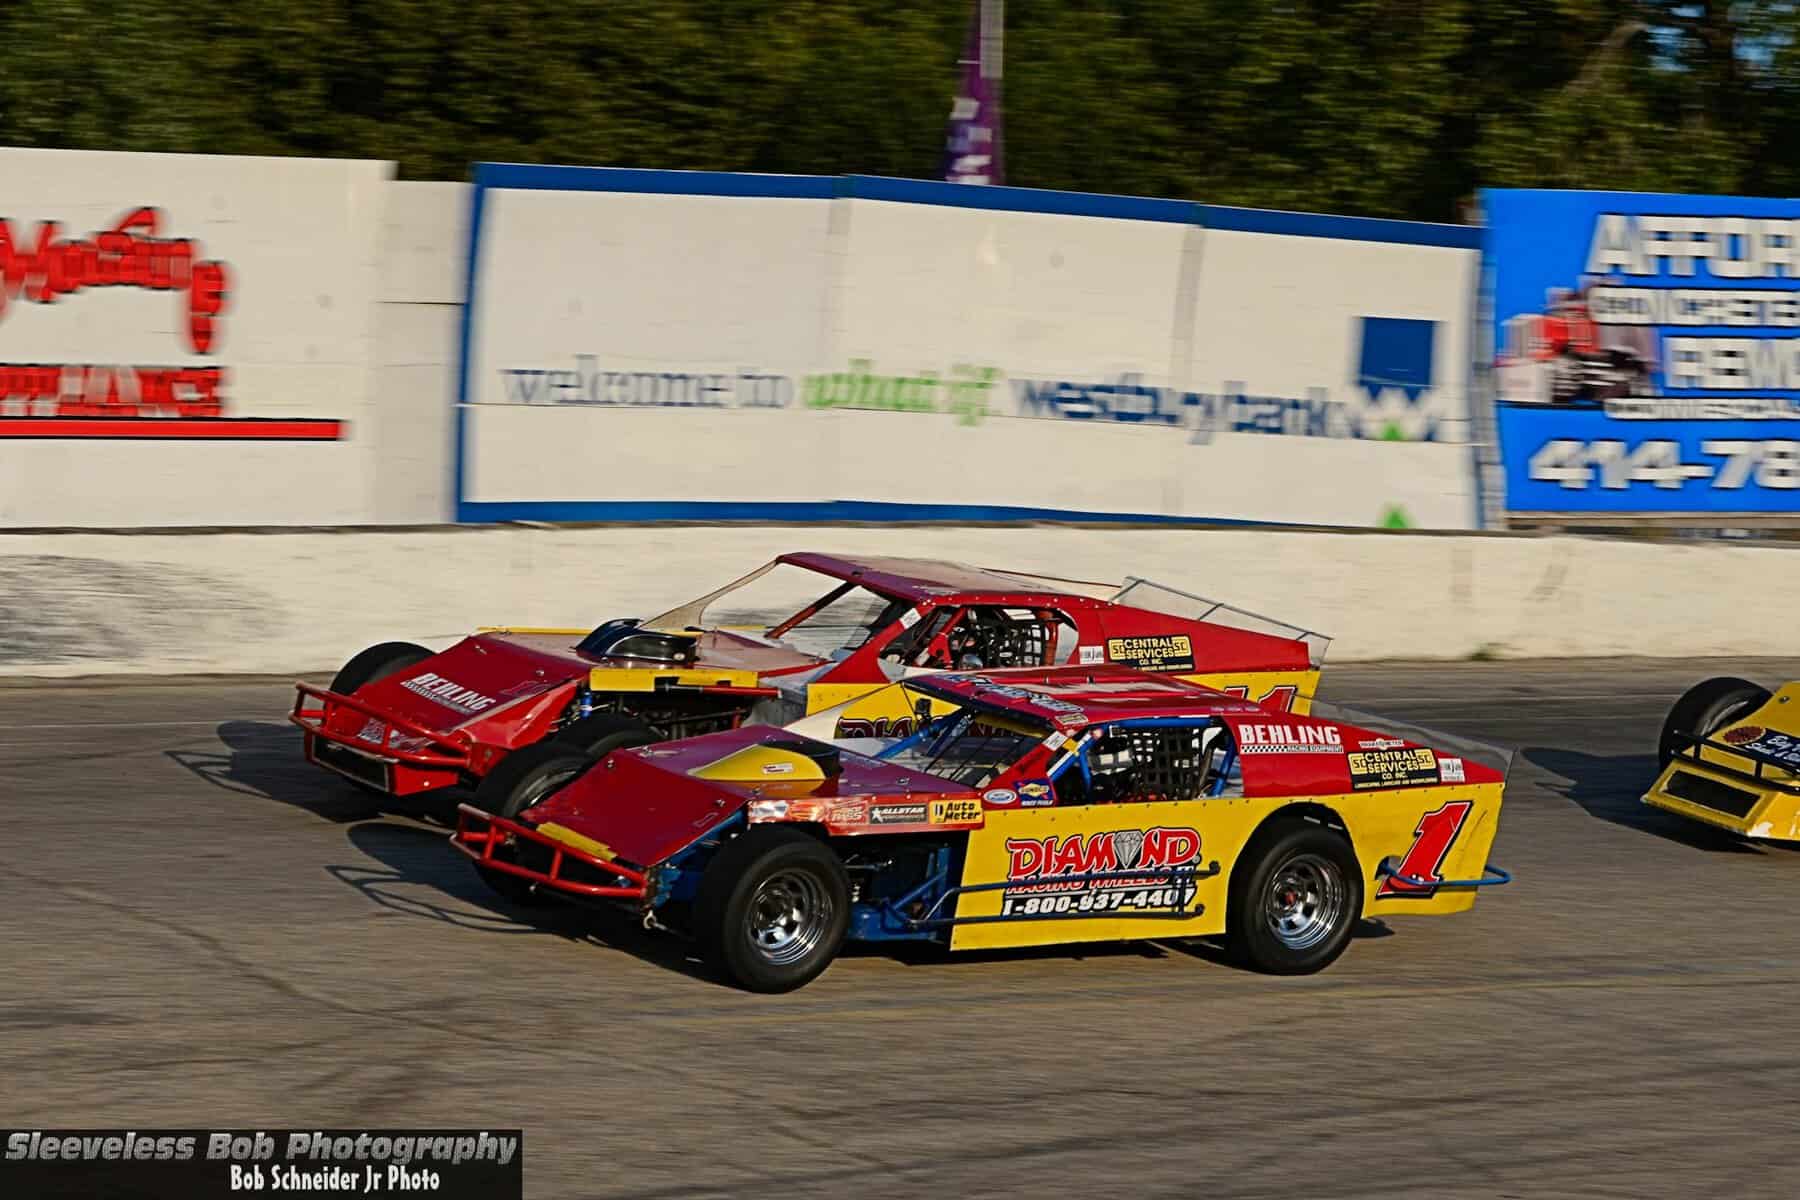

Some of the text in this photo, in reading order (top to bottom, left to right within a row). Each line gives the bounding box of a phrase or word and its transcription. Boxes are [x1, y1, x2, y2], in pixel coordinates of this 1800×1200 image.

[499, 355, 731, 407] welcome
[1124, 638, 1172, 649] CENTRAL
[1126, 648, 1174, 659] SERVICES
[410, 672, 496, 711] BEHLING
[1238, 724, 1341, 745] BEHLING
[1365, 750, 1417, 763] CENTRAL
[1367, 760, 1419, 774] SERVICES
[881, 807, 925, 816] ALLSTAR
[947, 801, 975, 812] Auto
[944, 810, 982, 821] Meter
[1375, 800, 1474, 900] 1
